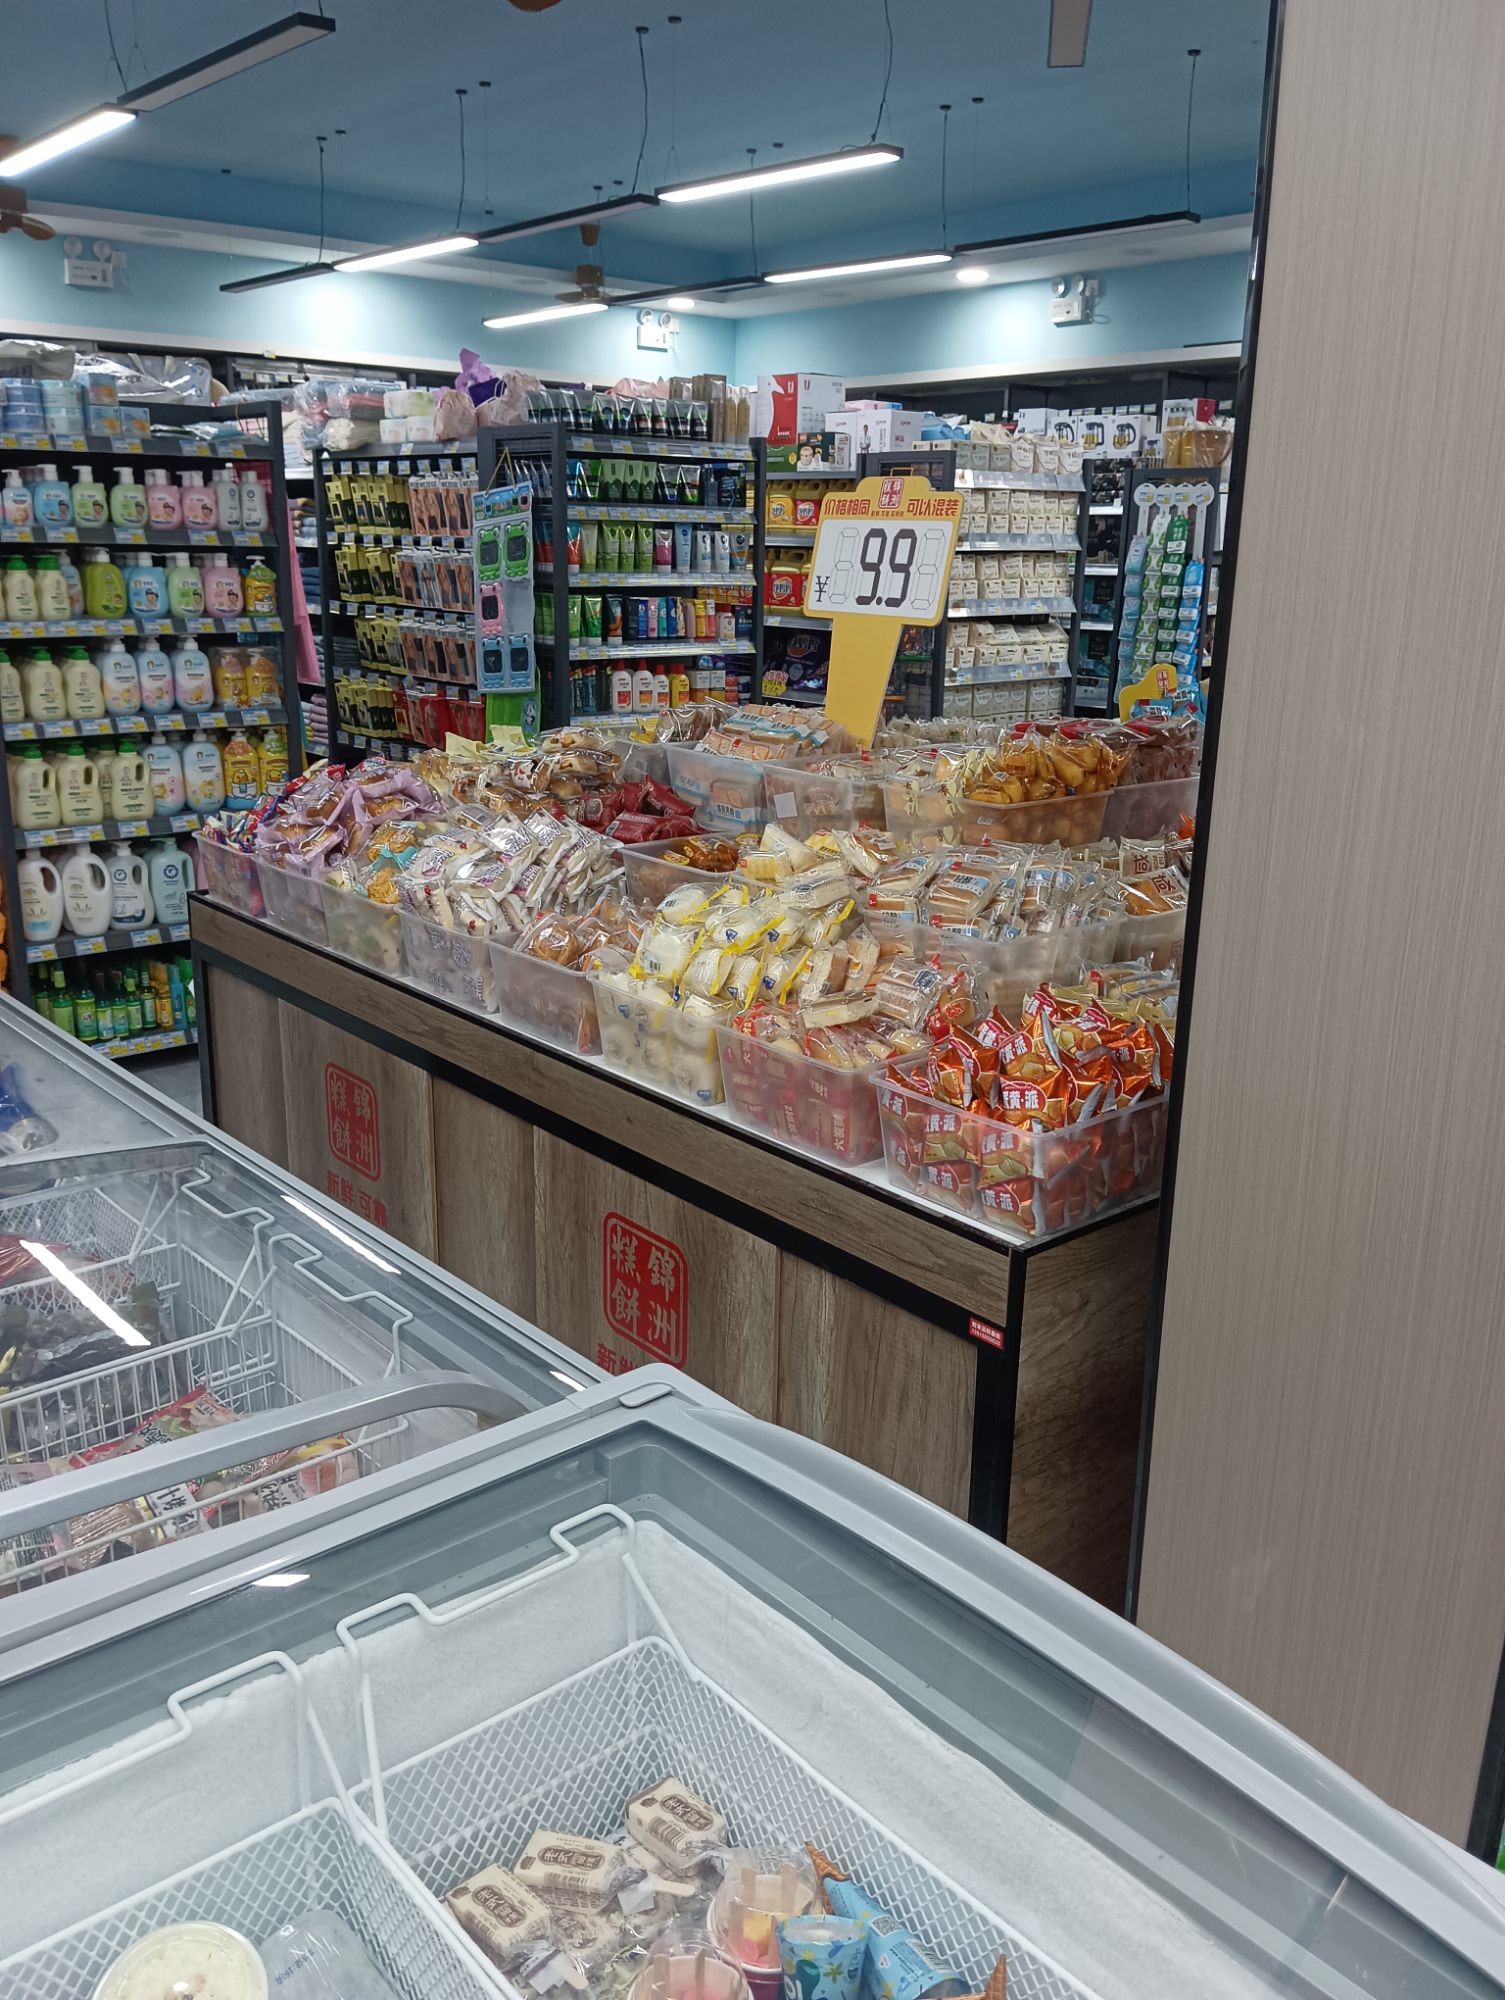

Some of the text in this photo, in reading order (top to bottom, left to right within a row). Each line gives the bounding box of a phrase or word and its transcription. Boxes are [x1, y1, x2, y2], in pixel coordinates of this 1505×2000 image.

[825, 498, 871, 516] 价格相同
[907, 498, 960, 517] 可以混装
[855, 527, 918, 608] 9.9
